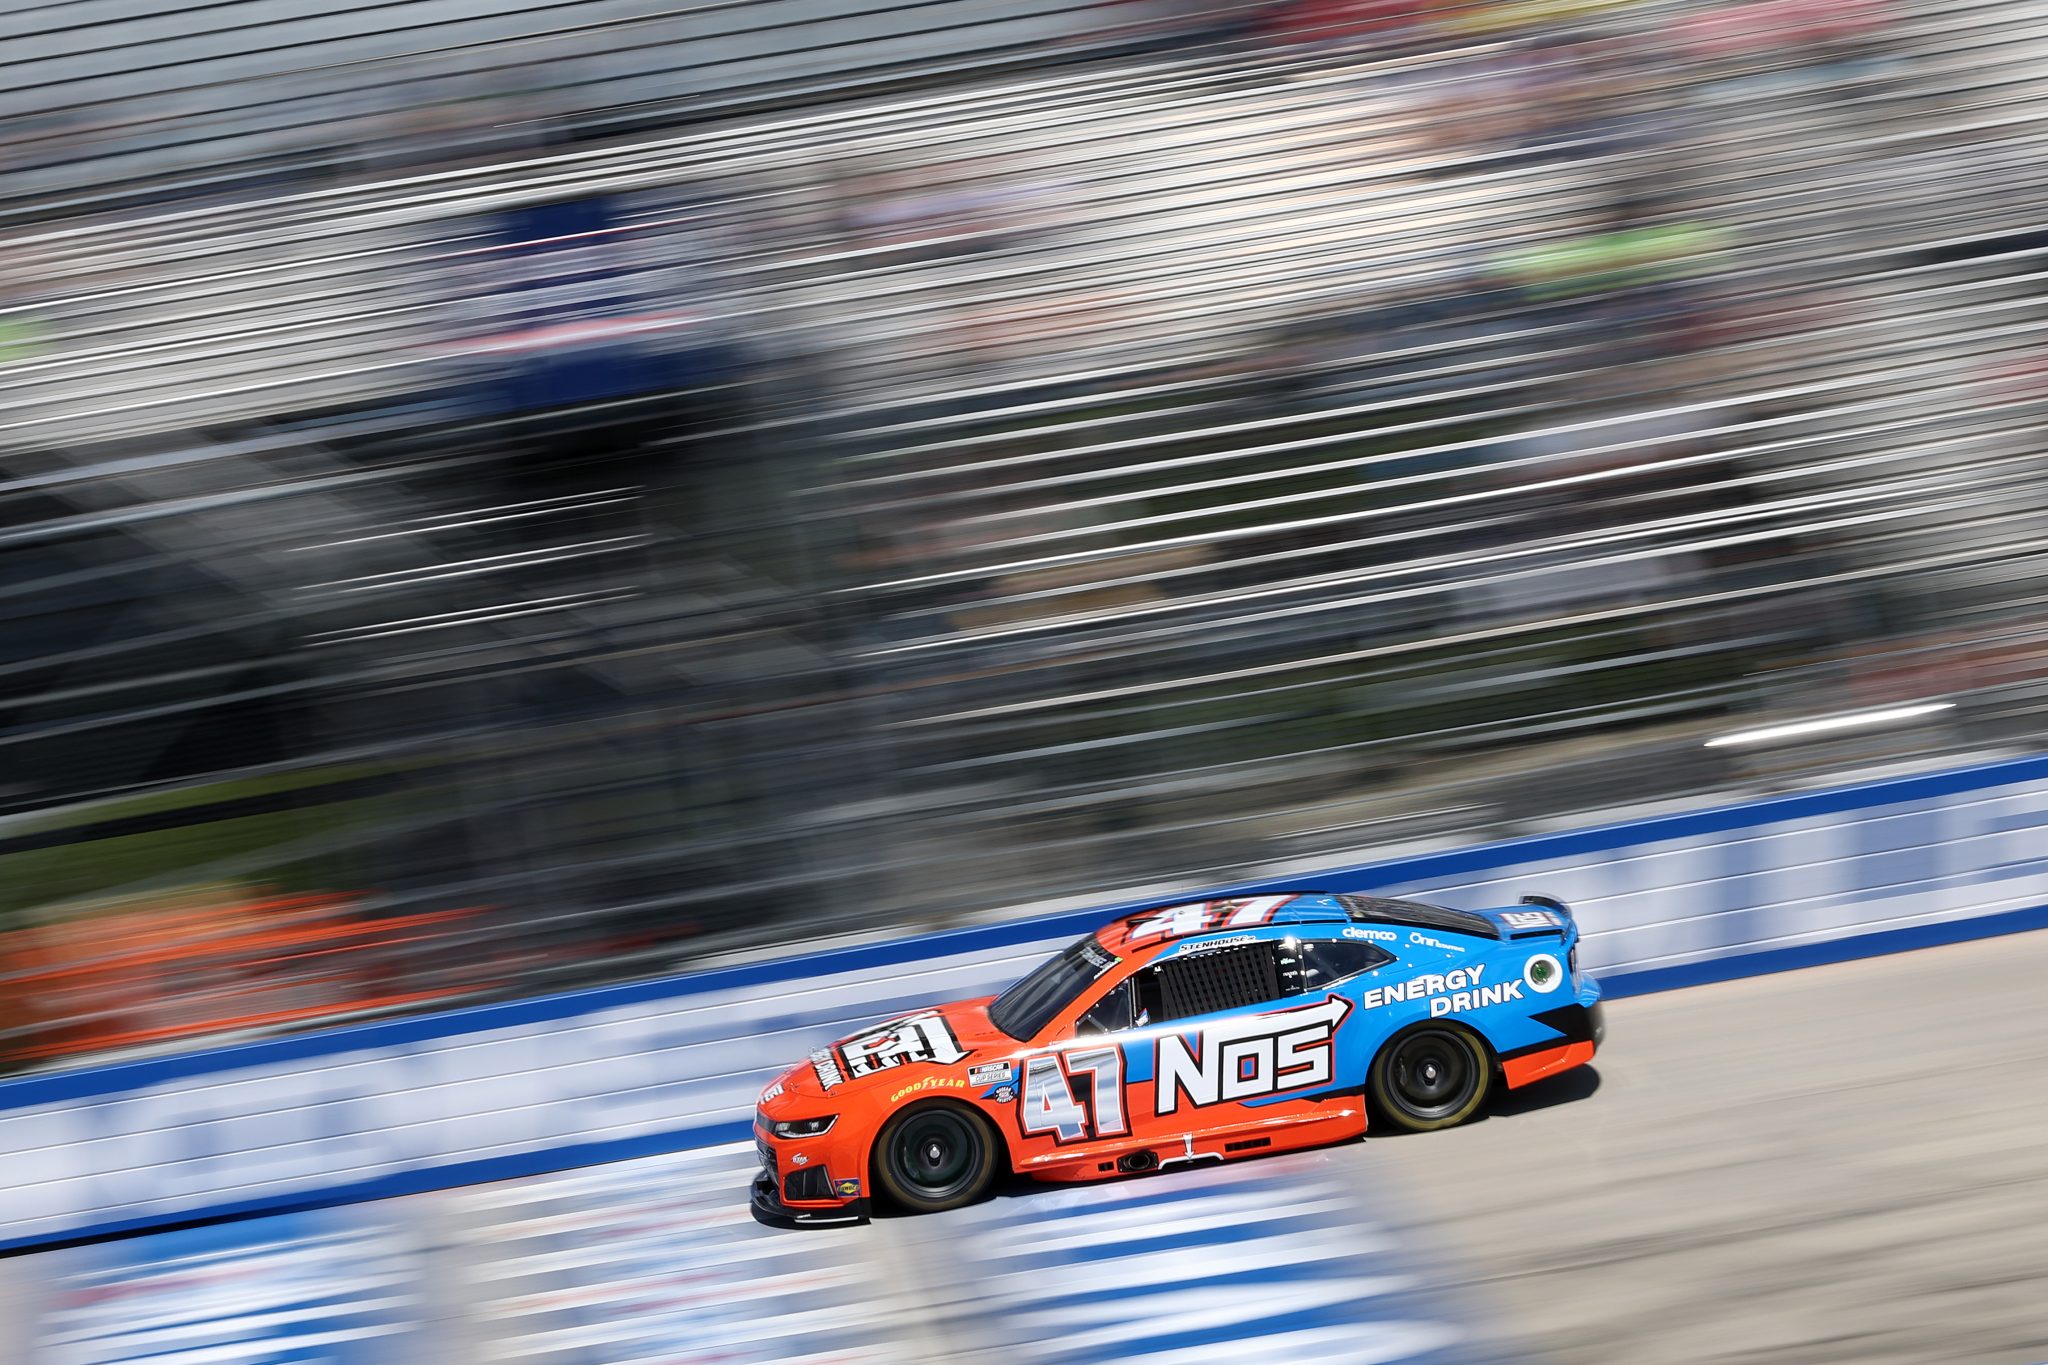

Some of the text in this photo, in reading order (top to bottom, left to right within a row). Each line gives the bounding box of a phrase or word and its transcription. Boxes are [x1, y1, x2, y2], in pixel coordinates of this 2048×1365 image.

[1128, 893, 1297, 940] 47
[1341, 926, 1397, 941] clemco
[1179, 936, 1250, 952] STENHOUSE
[1363, 963, 1486, 1010] ENERGY
[1429, 978, 1525, 1019] DRINK
[1156, 997, 1351, 1116] NOS
[890, 1076, 965, 1102] GOODYEAR
[1019, 1044, 1127, 1143] 47
